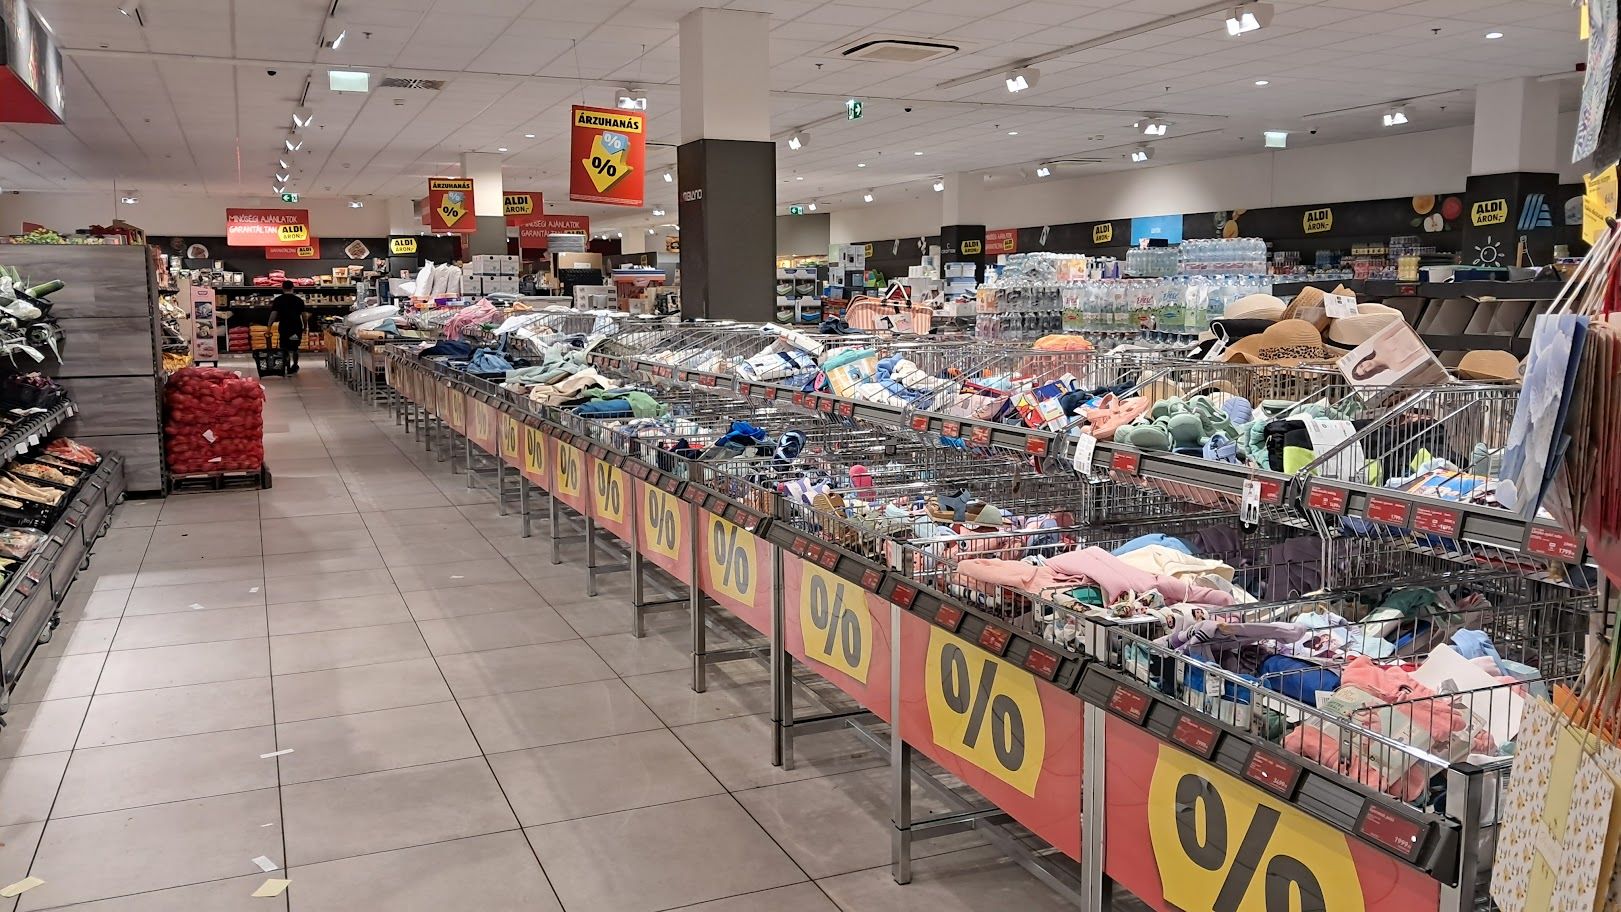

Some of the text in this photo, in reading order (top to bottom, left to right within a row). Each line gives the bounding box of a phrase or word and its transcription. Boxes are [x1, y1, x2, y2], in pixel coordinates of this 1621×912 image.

[578, 112, 639, 130] ÁRZUHANÁS
[592, 157, 616, 176] %
[504, 196, 528, 205] ALDI
[1308, 210, 1328, 222] ALDI
[1477, 201, 1502, 214] ALDI
[1096, 224, 1110, 234] ALDI
[560, 444, 578, 490] %
[597, 461, 620, 516] %
[649, 489, 675, 550] %
[713, 520, 748, 594] %
[810, 574, 861, 668] %
[941, 642, 1025, 771] %
[1175, 773, 1326, 912] %
